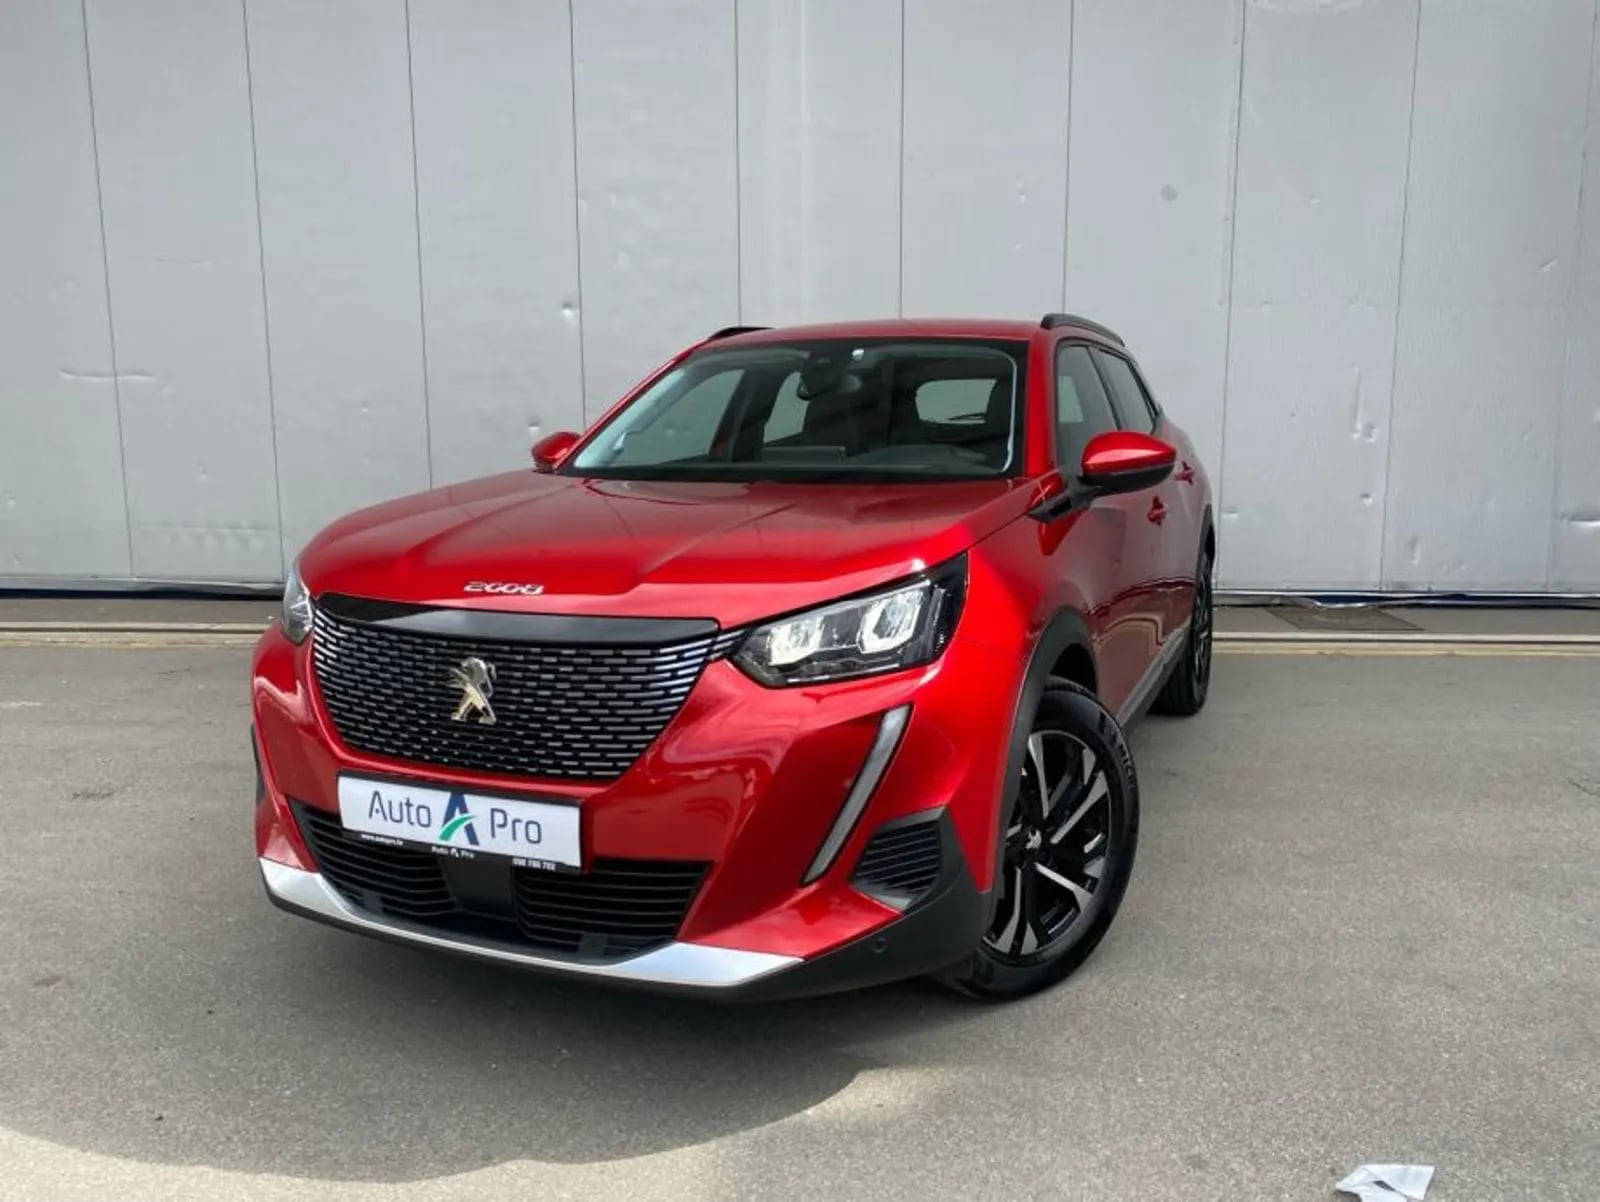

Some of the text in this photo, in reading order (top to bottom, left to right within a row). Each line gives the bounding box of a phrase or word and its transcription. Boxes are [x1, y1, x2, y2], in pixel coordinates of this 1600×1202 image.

[463, 581, 544, 596] 2008
[368, 790, 432, 828] Auto
[490, 807, 542, 845] Pro
